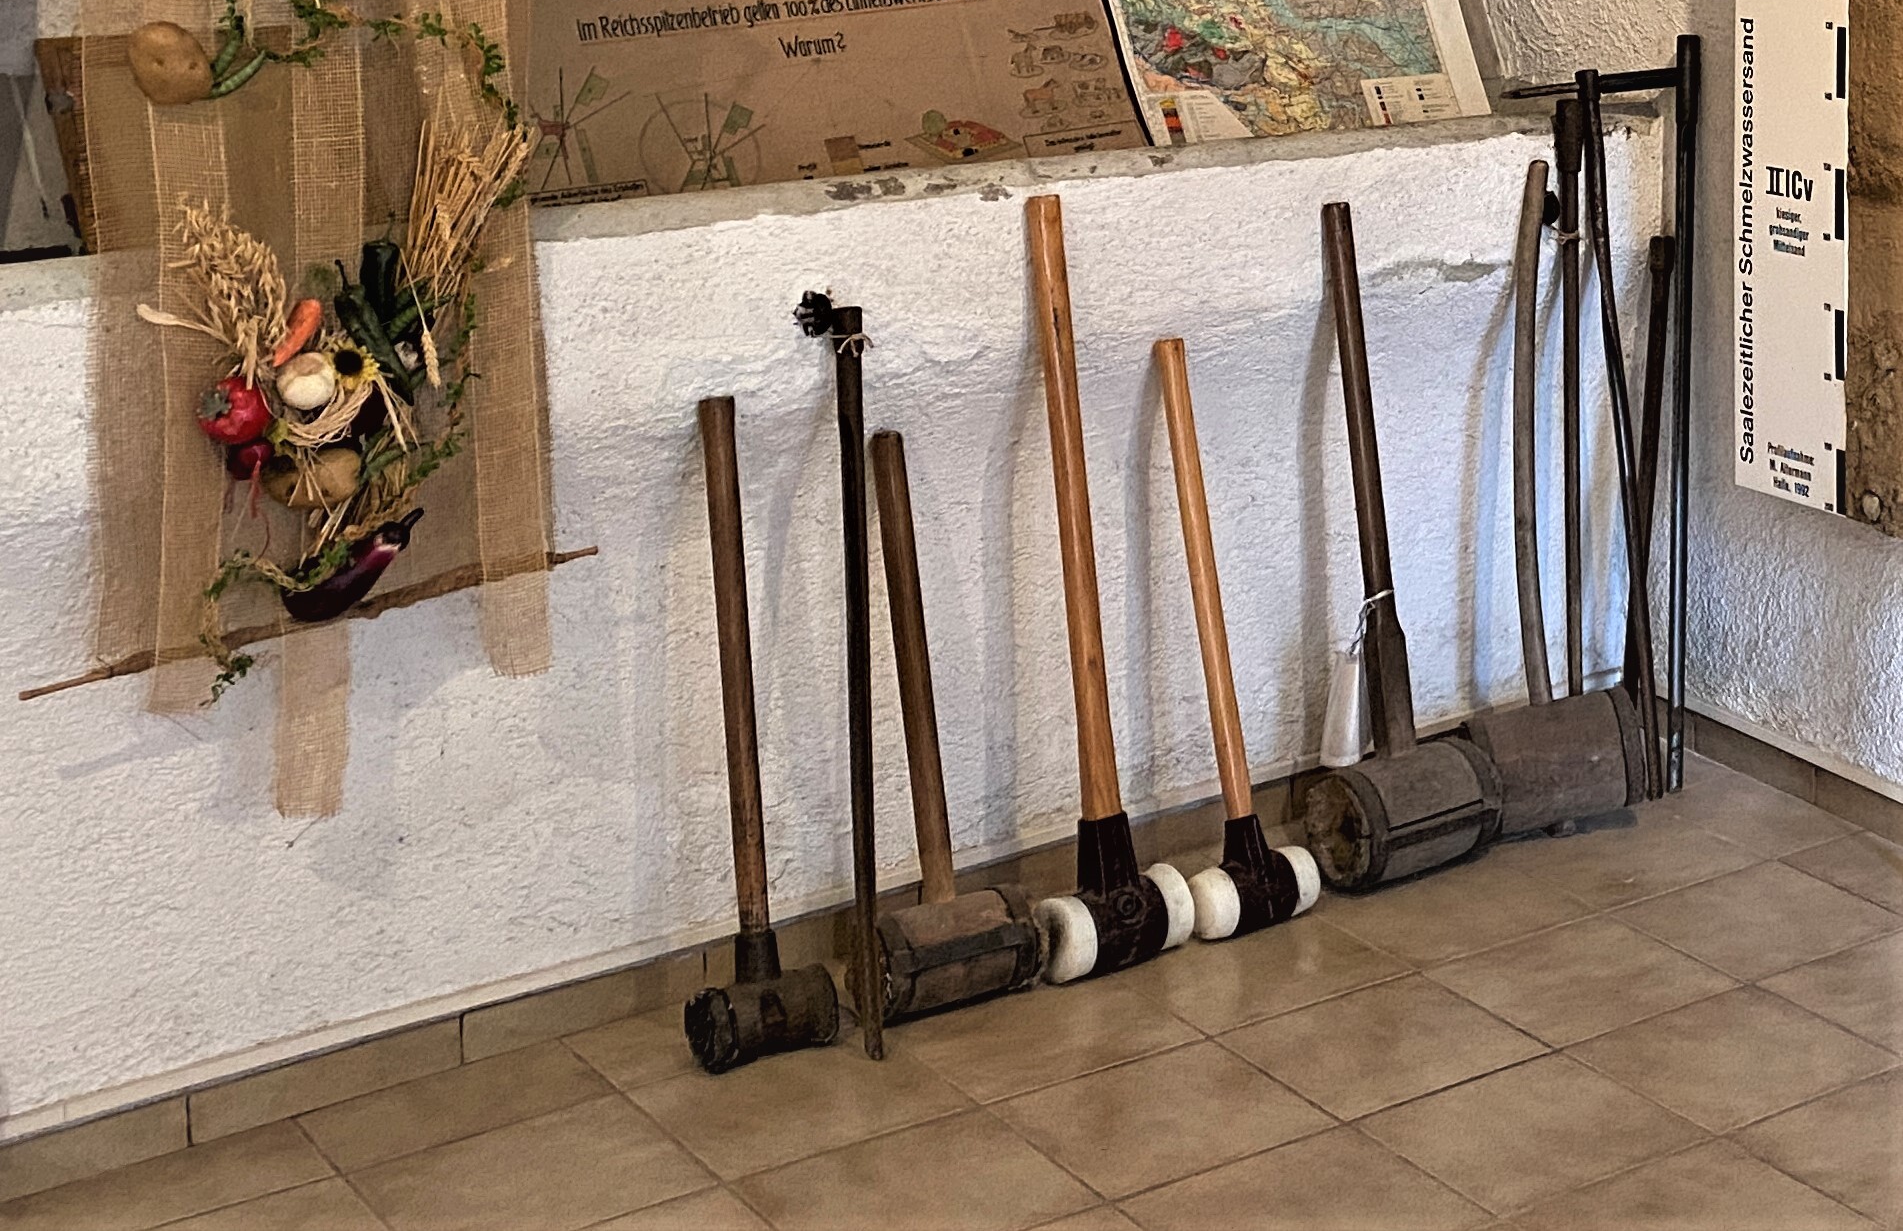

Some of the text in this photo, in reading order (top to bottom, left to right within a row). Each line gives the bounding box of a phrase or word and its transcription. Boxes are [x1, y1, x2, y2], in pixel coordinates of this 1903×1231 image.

[576, 18, 598, 42] Im
[598, 3, 740, 38] Reichsspitzenbetrieb
[744, 0, 781, 28] gelten
[778, 31, 848, 59] Warum?
[1739, 17, 1754, 464] Saalezeitlicher Schmelzwassersand
